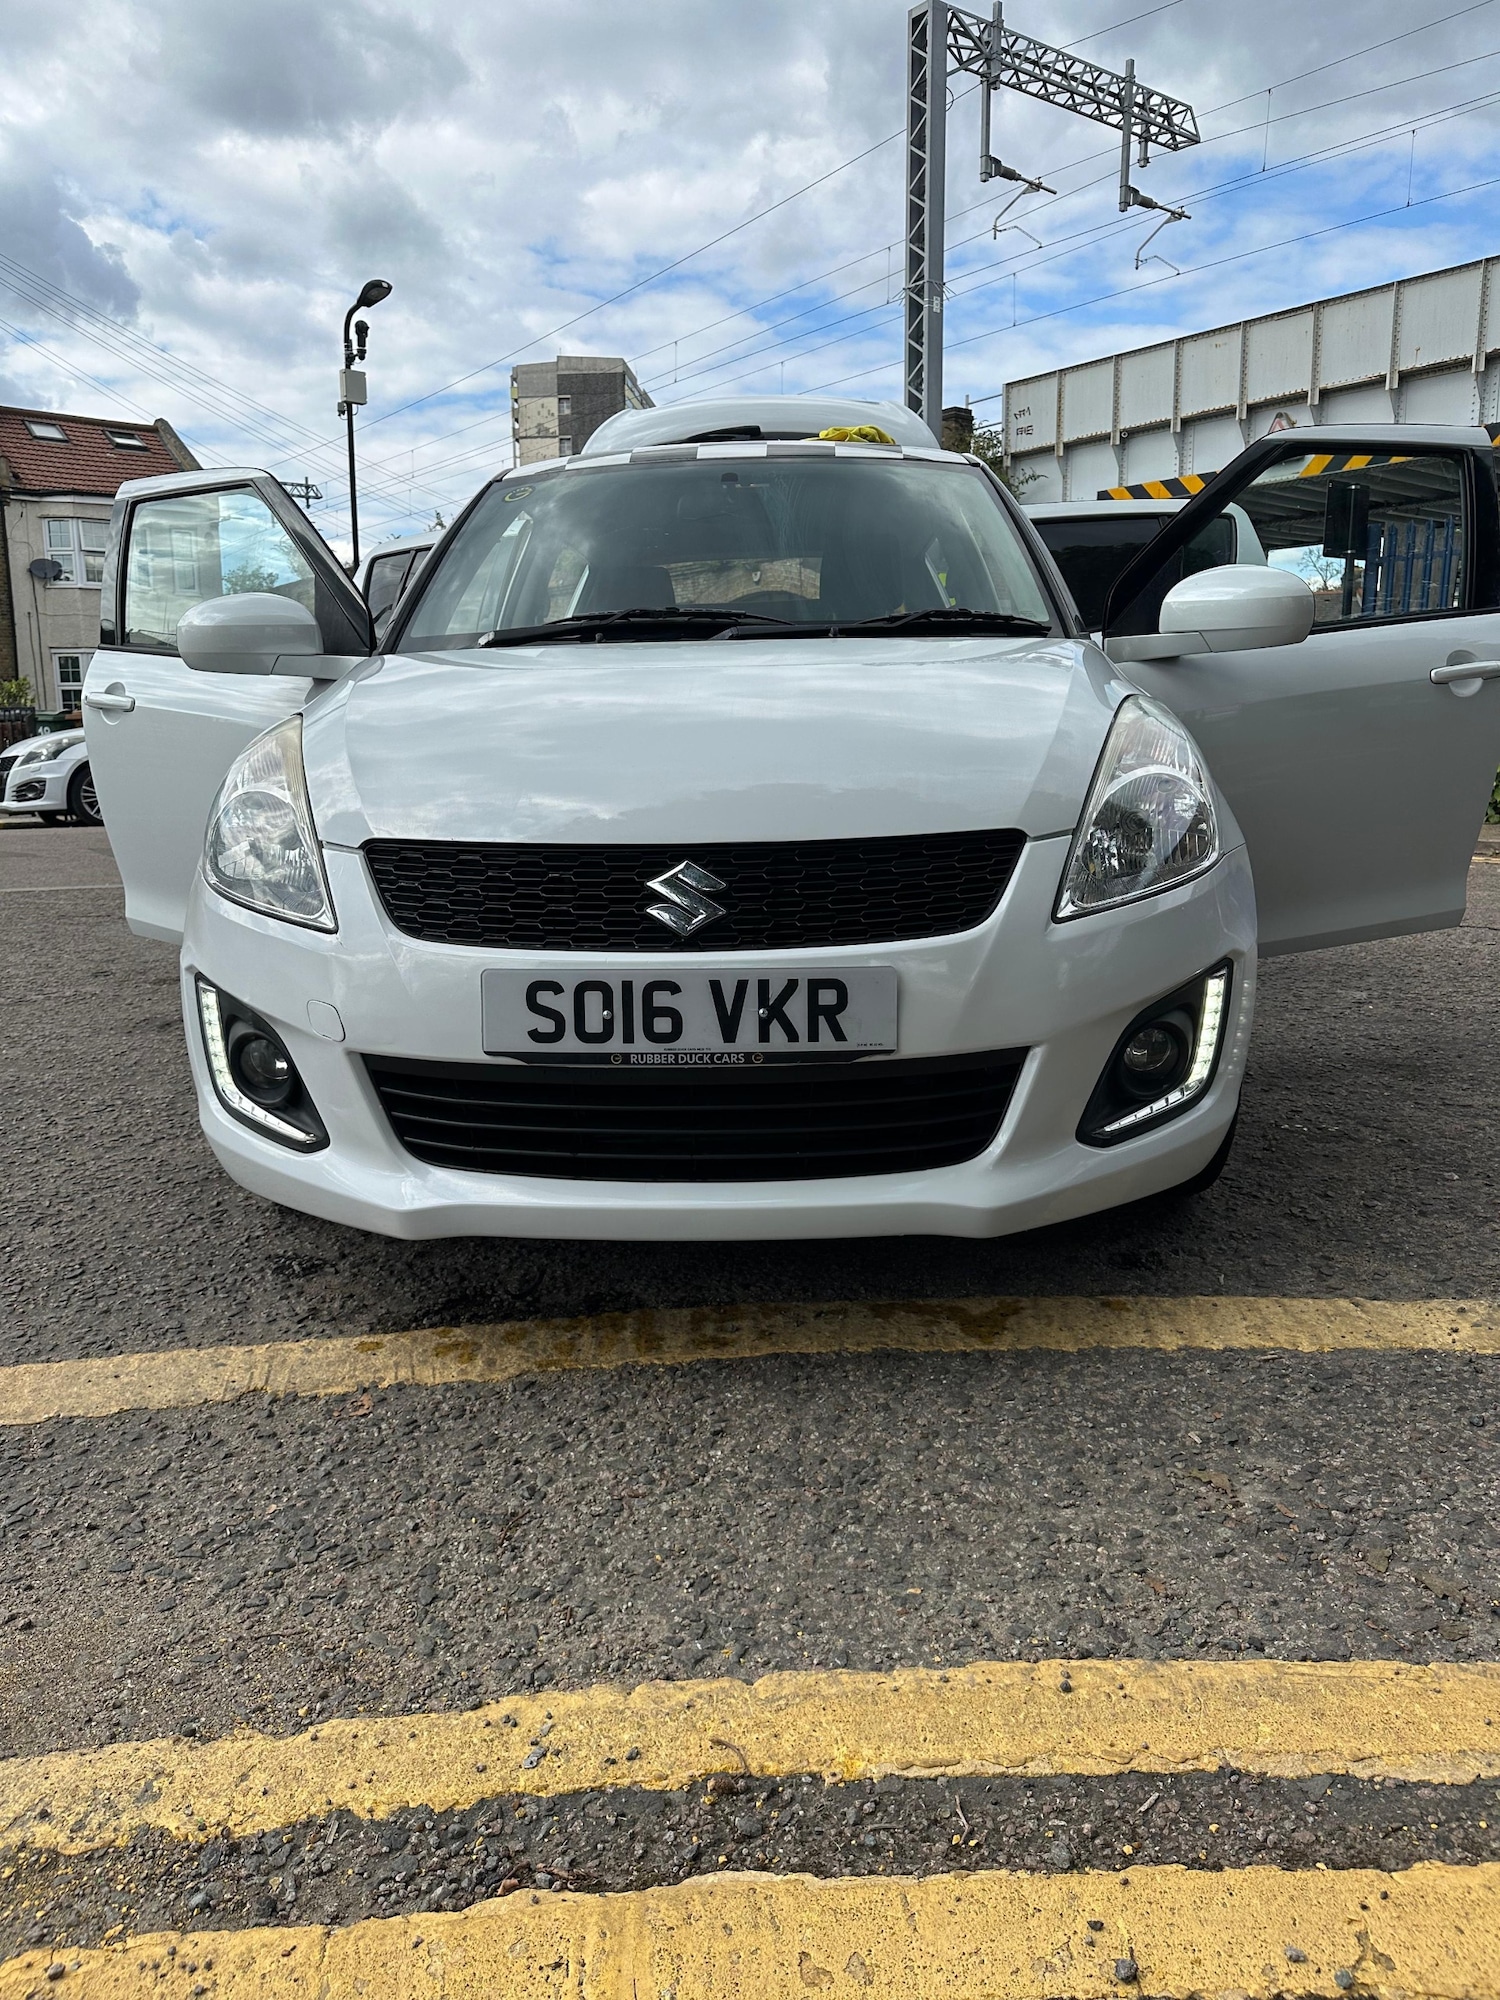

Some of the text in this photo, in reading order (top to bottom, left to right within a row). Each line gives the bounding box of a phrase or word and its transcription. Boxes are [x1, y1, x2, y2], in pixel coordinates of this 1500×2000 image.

[525, 978, 848, 1044] SO16 VKR
[630, 1053, 675, 1064] RUBBER
[678, 1053, 711, 1064] DUCK
[713, 1053, 745, 1064] CARS
